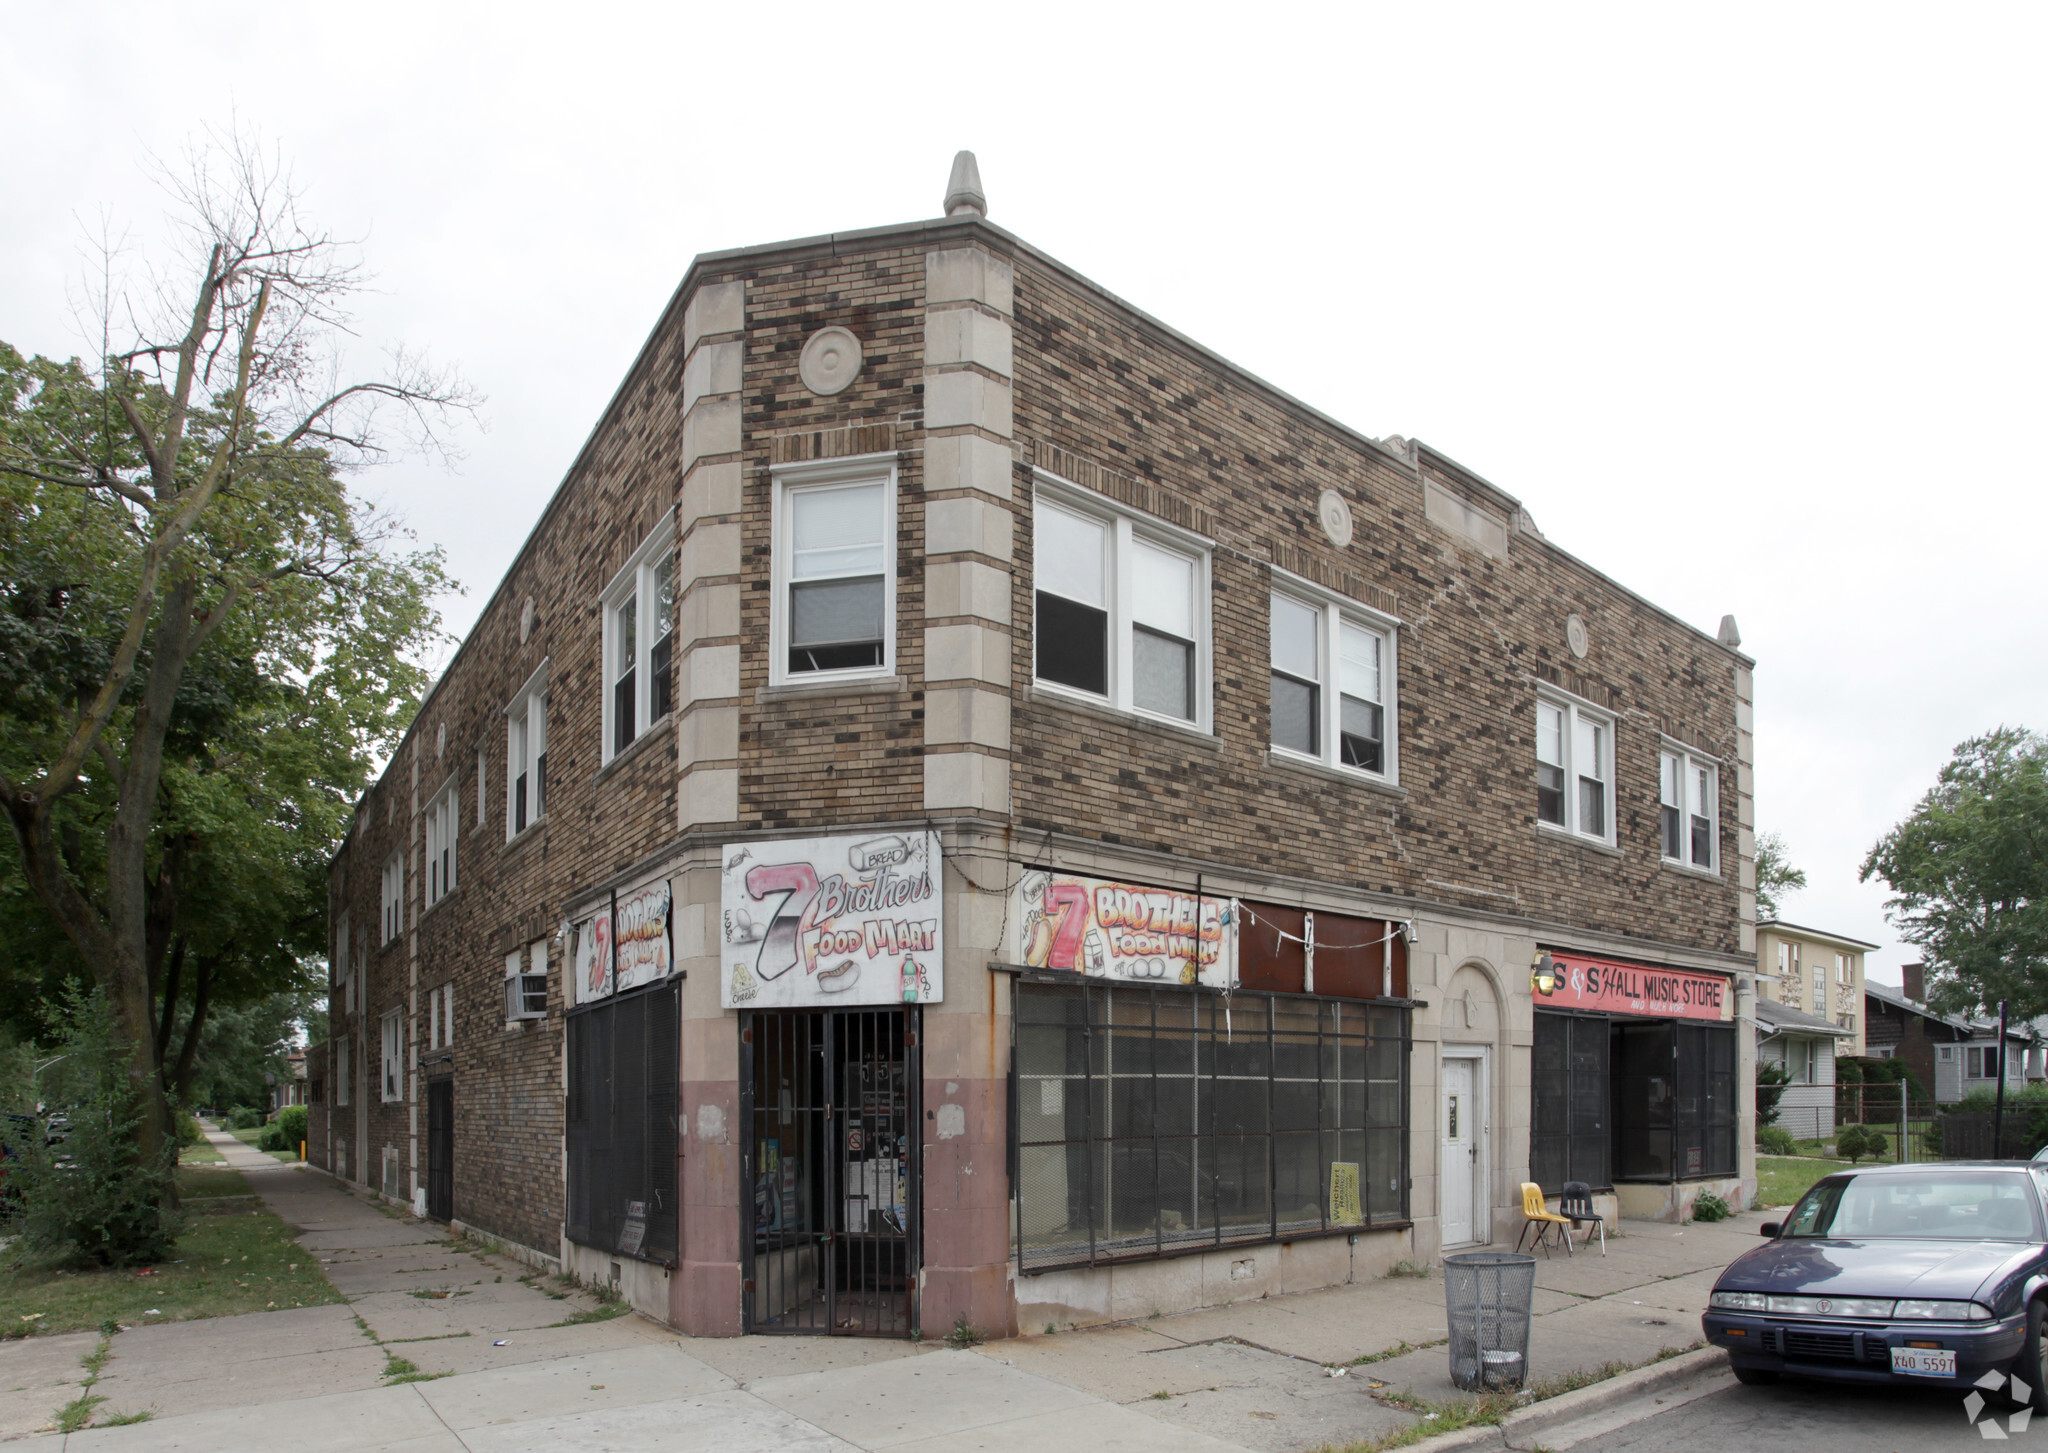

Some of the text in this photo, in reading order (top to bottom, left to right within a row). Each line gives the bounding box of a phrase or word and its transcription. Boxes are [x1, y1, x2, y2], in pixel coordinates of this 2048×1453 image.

[868, 849, 902, 867] BREAD
[745, 862, 934, 981] 7 Brothers
[863, 919, 938, 960] MART
[1044, 886, 1221, 970] 7 BROTHERS
[1553, 962, 1721, 1008] S & S HALL MUSIC STORE
[1923, 1358, 1954, 1373] 5597
